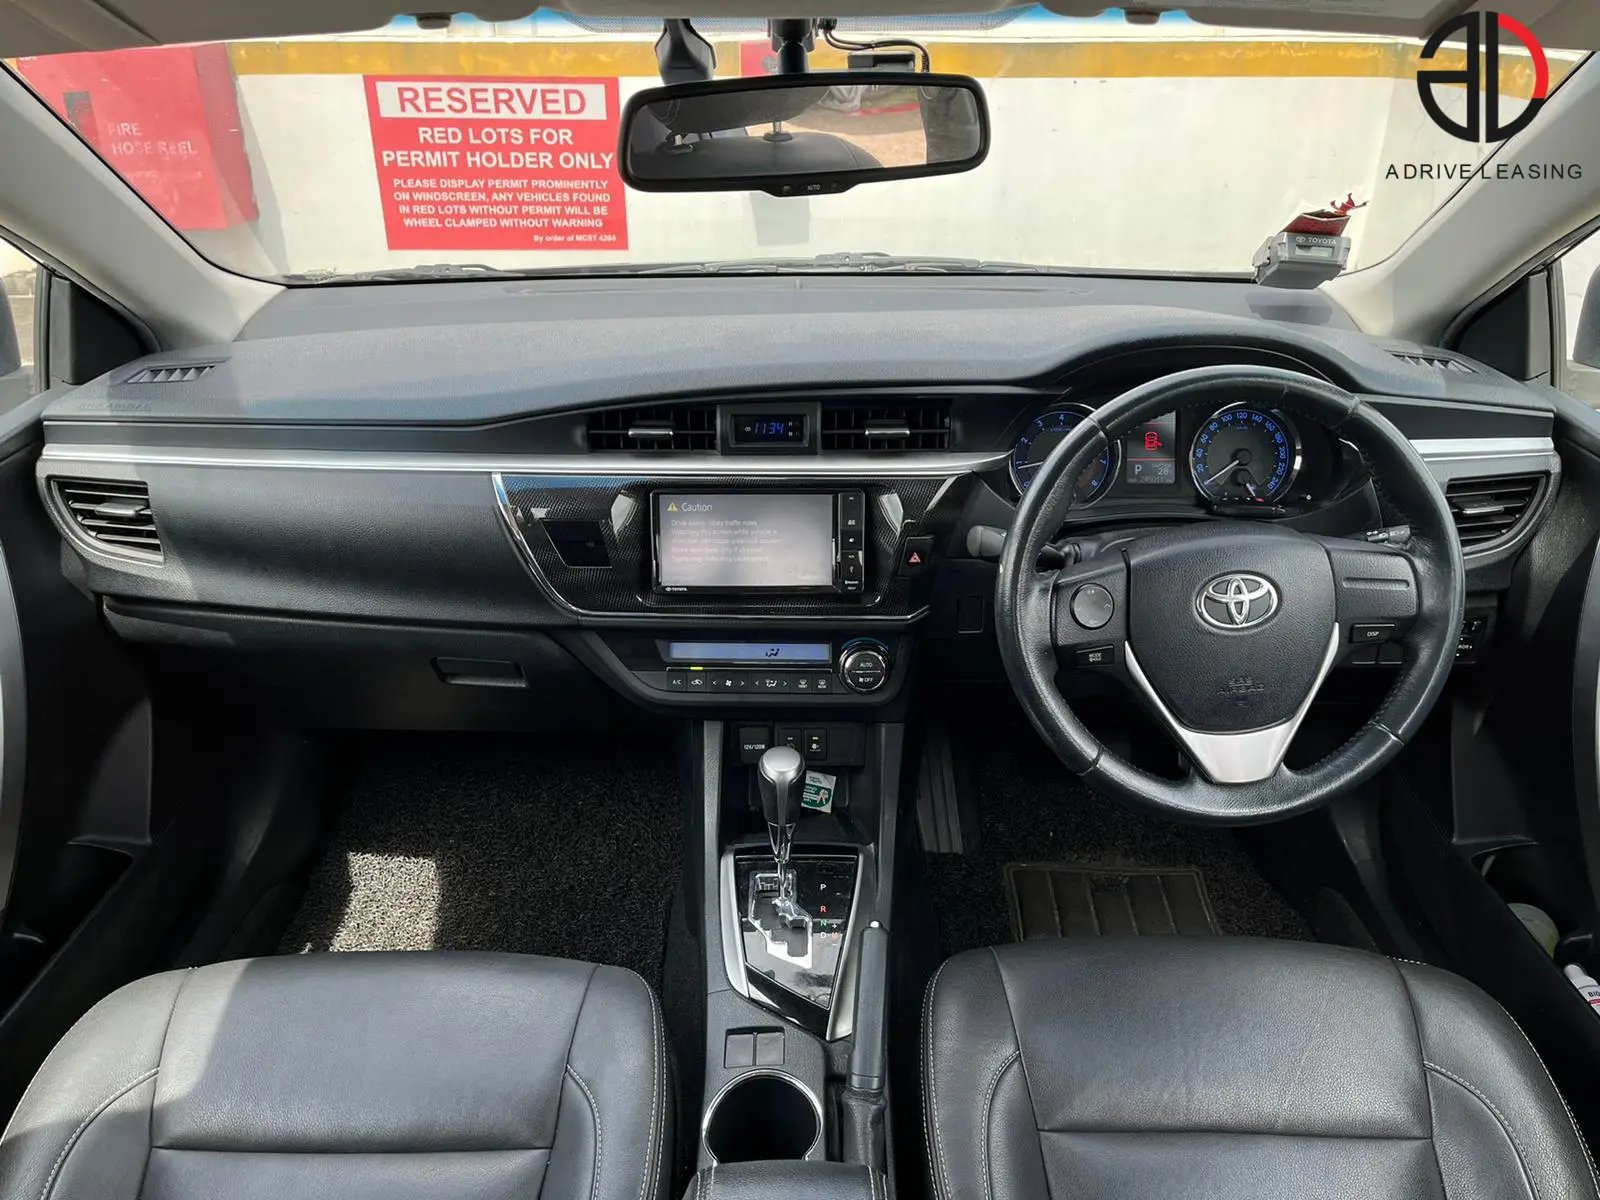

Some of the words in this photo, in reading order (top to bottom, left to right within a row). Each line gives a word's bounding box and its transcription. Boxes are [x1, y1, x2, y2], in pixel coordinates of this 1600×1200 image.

[397, 86, 587, 116] RESERVED
[107, 122, 143, 136] FIRE
[418, 127, 462, 144] RED
[468, 127, 524, 145] LOTS
[530, 128, 574, 145] FOR
[381, 150, 460, 168] PERMIT
[466, 152, 553, 169] HOLDER
[559, 152, 614, 169] ONLY
[393, 178, 438, 188] PLEASE
[439, 179, 485, 188] DISPLAY
[488, 179, 528, 189] PERMIT
[531, 179, 608, 189] PROMINENTLY
[393, 191, 410, 201] ON
[491, 192, 514, 202] ANY
[516, 192, 570, 202] VEHICLES
[573, 193, 611, 202] FOUND
[399, 205, 410, 214] IN
[412, 205, 435, 214] RED
[438, 205, 467, 214] LOTS
[469, 205, 519, 215] WITHOUT
[521, 205, 562, 215] PERMIT
[564, 206, 591, 215] WILL
[593, 206, 608, 215] BE
[403, 218, 442, 228] WHEEL
[444, 218, 497, 228] CLAMPED
[500, 218, 549, 228] WITHOUT
[551, 218, 604, 228] WARNING
[1308, 236, 1337, 245] TOYOTA
[1059, 413, 1065, 421] 4
[1220, 413, 1233, 423] 100
[1236, 411, 1248, 420] 120
[1251, 413, 1263, 423] 140
[1208, 421, 1218, 432] 80
[1264, 420, 1276, 432] 160
[1200, 433, 1209, 444] 60
[1274, 431, 1284, 444] 180
[1195, 448, 1204, 458] 40
[1278, 446, 1286, 460] 200
[1135, 464, 1142, 475] P
[1196, 463, 1205, 473] 20
[1276, 462, 1286, 476] 220
[1267, 476, 1279, 490] 240
[681, 502, 713, 512] Caution
[820, 883, 827, 891] P
[820, 905, 827, 913] R
[820, 931, 827, 939] D
